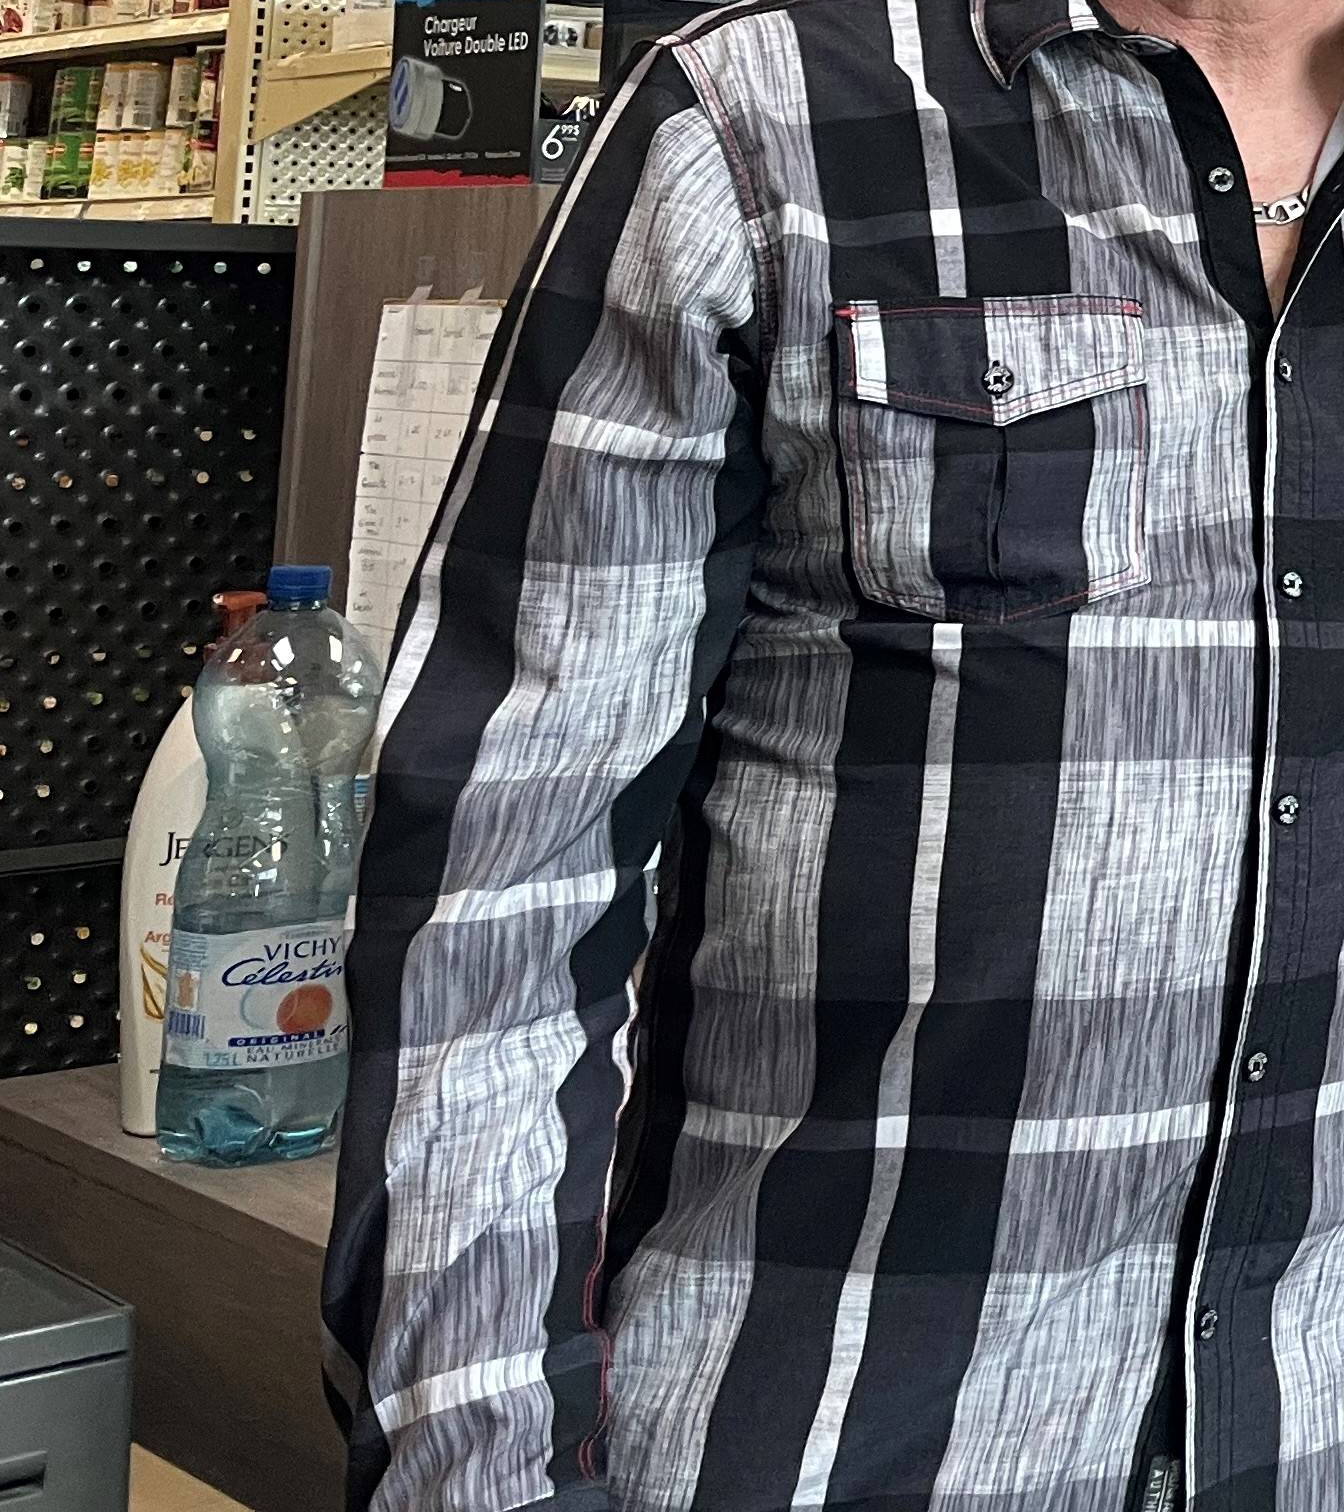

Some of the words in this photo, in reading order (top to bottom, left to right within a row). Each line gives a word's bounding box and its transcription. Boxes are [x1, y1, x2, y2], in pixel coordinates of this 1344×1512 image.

[424, 16, 478, 36] Chargeur
[423, 38, 463, 57] Voiture
[464, 33, 506, 55] Double
[508, 31, 529, 51] LED
[264, 936, 342, 962] VICHY
